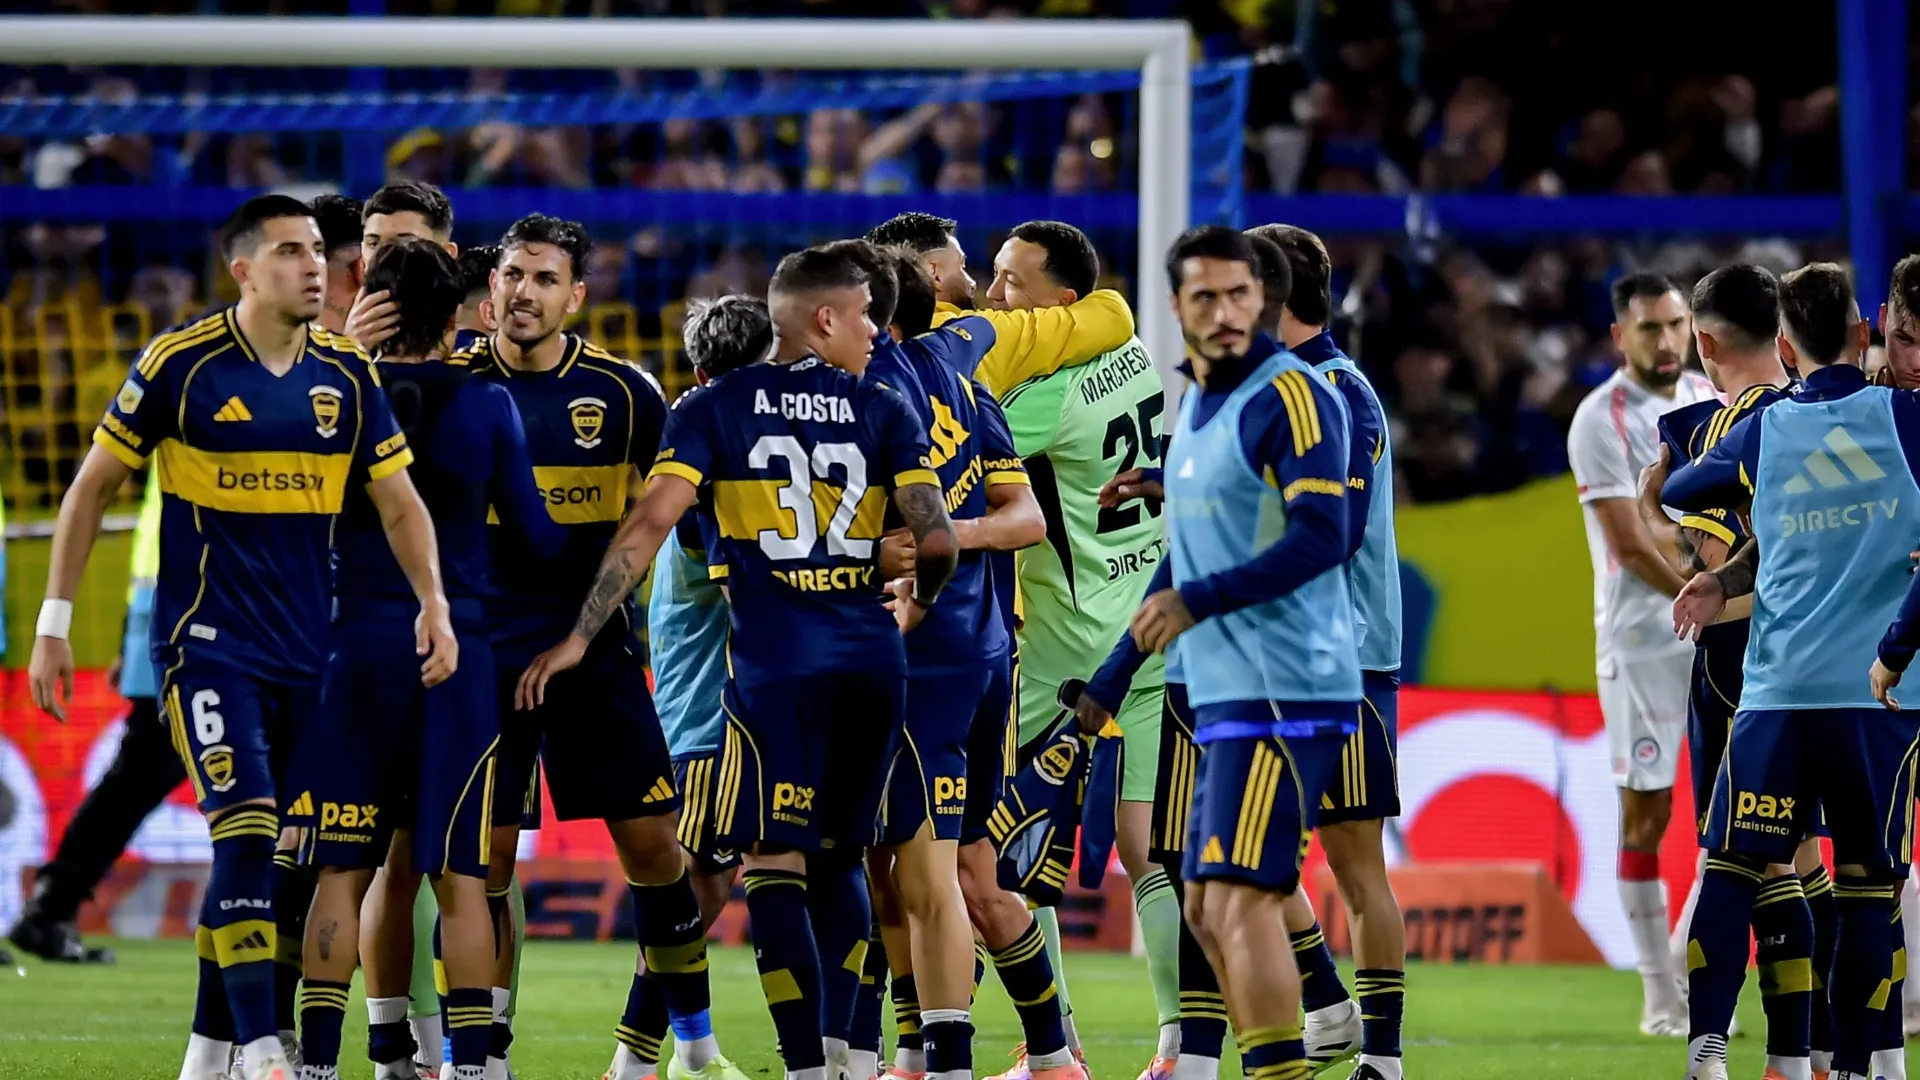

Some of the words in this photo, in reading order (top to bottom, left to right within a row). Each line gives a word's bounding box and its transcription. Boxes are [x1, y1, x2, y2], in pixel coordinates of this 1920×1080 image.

[754, 389, 778, 414] A.
[780, 392, 856, 424] COSTA
[748, 435, 873, 561] 32
[1778, 498, 1899, 538] DIRECTV
[190, 688, 226, 746] 6
[320, 801, 380, 831] pax
[1736, 790, 1797, 821] pax
